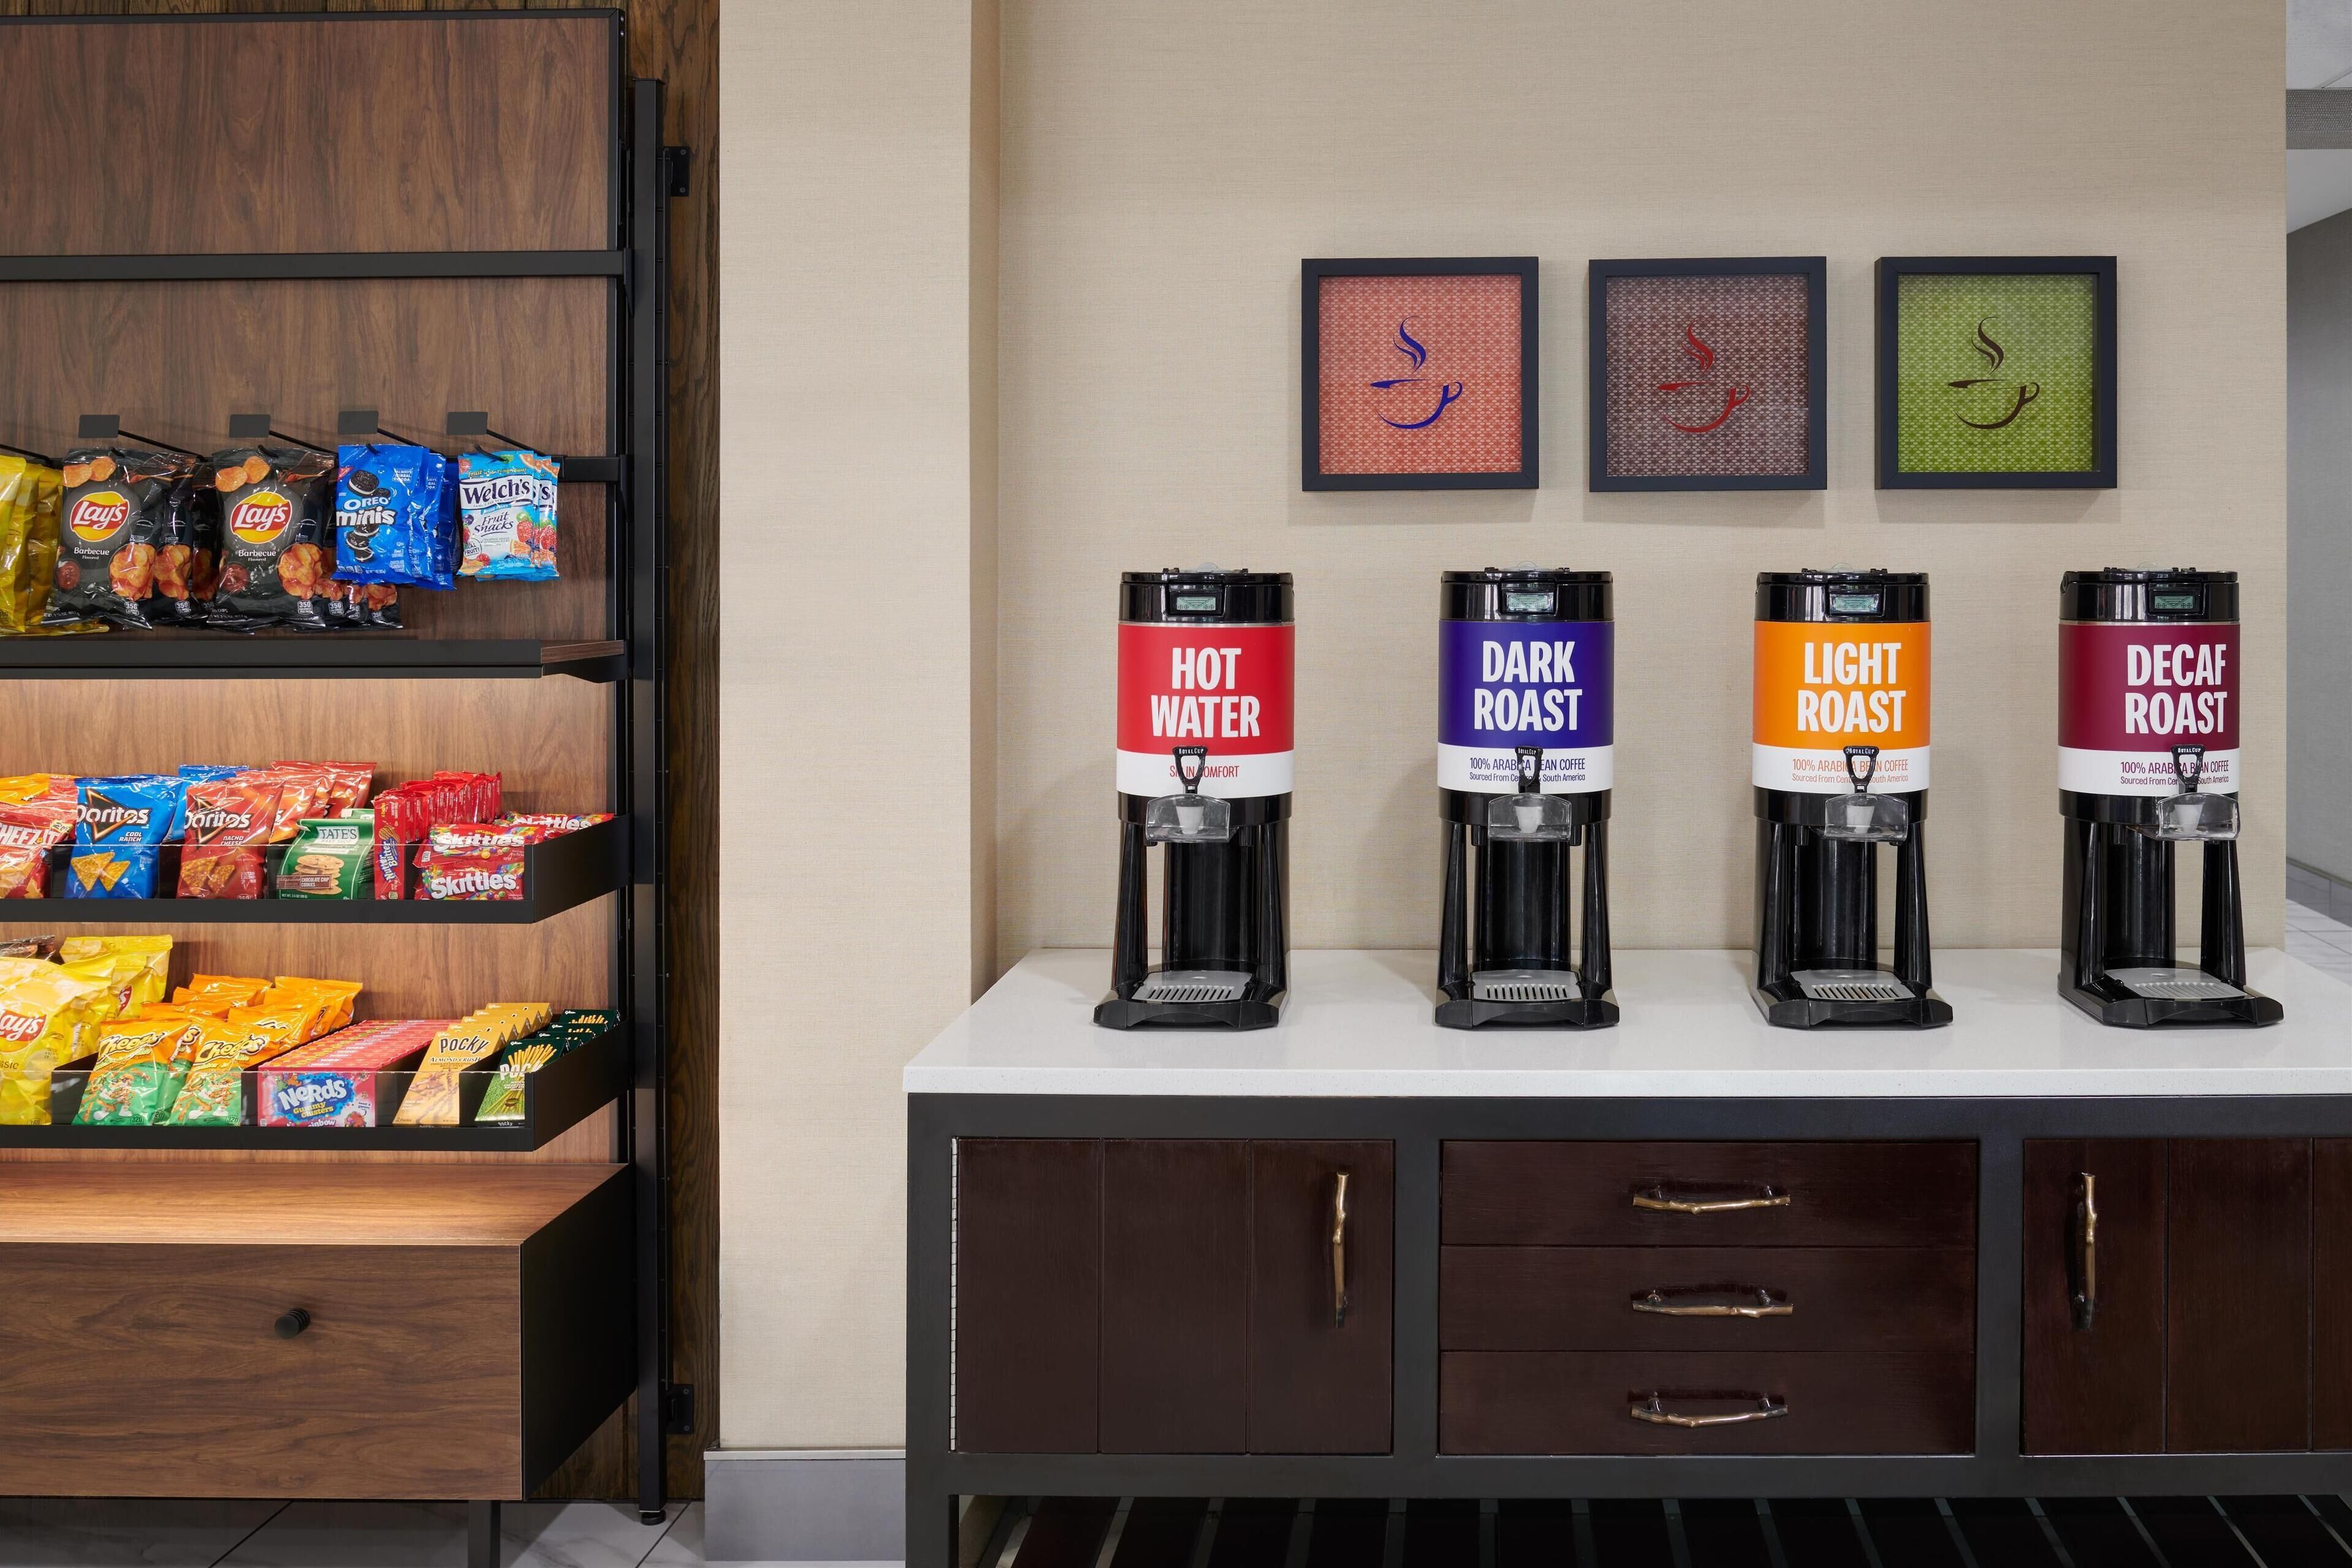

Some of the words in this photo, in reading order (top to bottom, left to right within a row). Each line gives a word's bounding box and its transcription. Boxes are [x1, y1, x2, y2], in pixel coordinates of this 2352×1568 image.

[463, 479, 530, 504] Welch's
[344, 497, 389, 511] OREO
[73, 501, 126, 530] Lay's
[234, 504, 289, 531] Lay's
[337, 506, 396, 527] minis
[482, 511, 509, 525] Fruit
[474, 520, 514, 533] Snacks
[74, 547, 110, 555] Barbecue
[1172, 647, 1241, 690] HOT
[1483, 641, 1575, 683] DARK
[1805, 642, 1901, 685] LIGHT
[2127, 644, 2227, 686] DECAF
[1151, 695, 1260, 738] WATER
[1474, 688, 1582, 731] ROAST
[1797, 690, 1906, 733] ROAST
[2125, 691, 2228, 734] ROAST
[1186, 766, 1195, 777] IN
[1201, 766, 1239, 777] OMFORT
[1470, 757, 1490, 770] 100%
[1539, 759, 1557, 771] EAN
[1559, 758, 1585, 771] COFFEE
[1792, 758, 1815, 771] 100%
[1860, 761, 1881, 772] BEN
[1884, 759, 1908, 772] COFFEE
[2121, 762, 2145, 774] 100%
[2148, 763, 2187, 774] ARABIA
[2190, 762, 2209, 774] BAN
[2211, 760, 2229, 772] COFFEE
[1469, 772, 1492, 781] Sourced
[1493, 773, 1509, 782] From
[1792, 774, 1817, 782] Sourced
[2121, 776, 2147, 785] Sourced
[2213, 775, 2229, 783] America
[77, 804, 150, 823] Doritos
[185, 810, 251, 829] Doritos
[319, 829, 357, 839] TATE'S
[433, 833, 524, 852] Skittles
[383, 841, 397, 867] Butter
[379, 854, 395, 881] Nutter
[431, 872, 517, 899] Skittles
[0, 1014, 44, 1041] ay's
[0, 1061, 18, 1070] ssic
[293, 1102, 326, 1114] Gummy
[301, 1106, 333, 1118] Clusters
